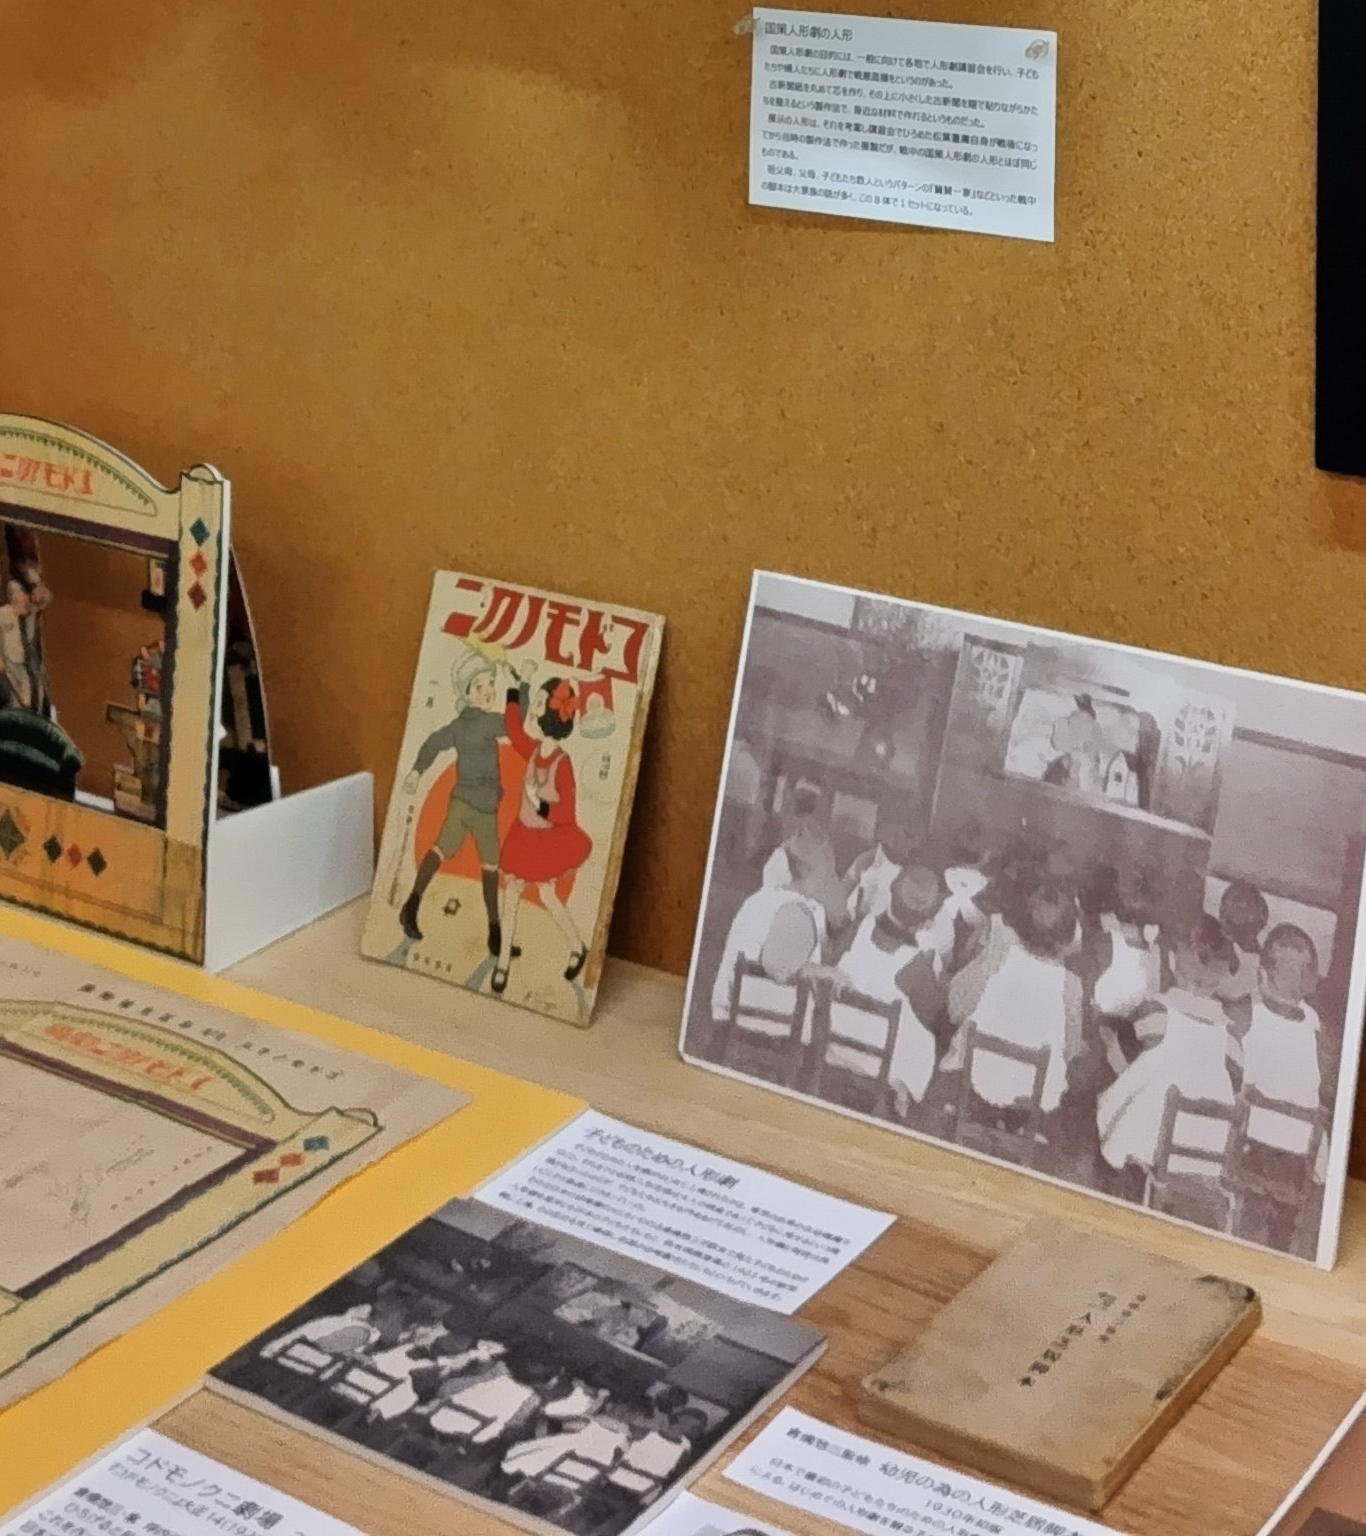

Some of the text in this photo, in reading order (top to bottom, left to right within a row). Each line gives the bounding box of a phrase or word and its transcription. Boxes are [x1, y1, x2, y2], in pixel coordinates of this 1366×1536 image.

[126, 1448, 285, 1530] コドモノクニ劇場
